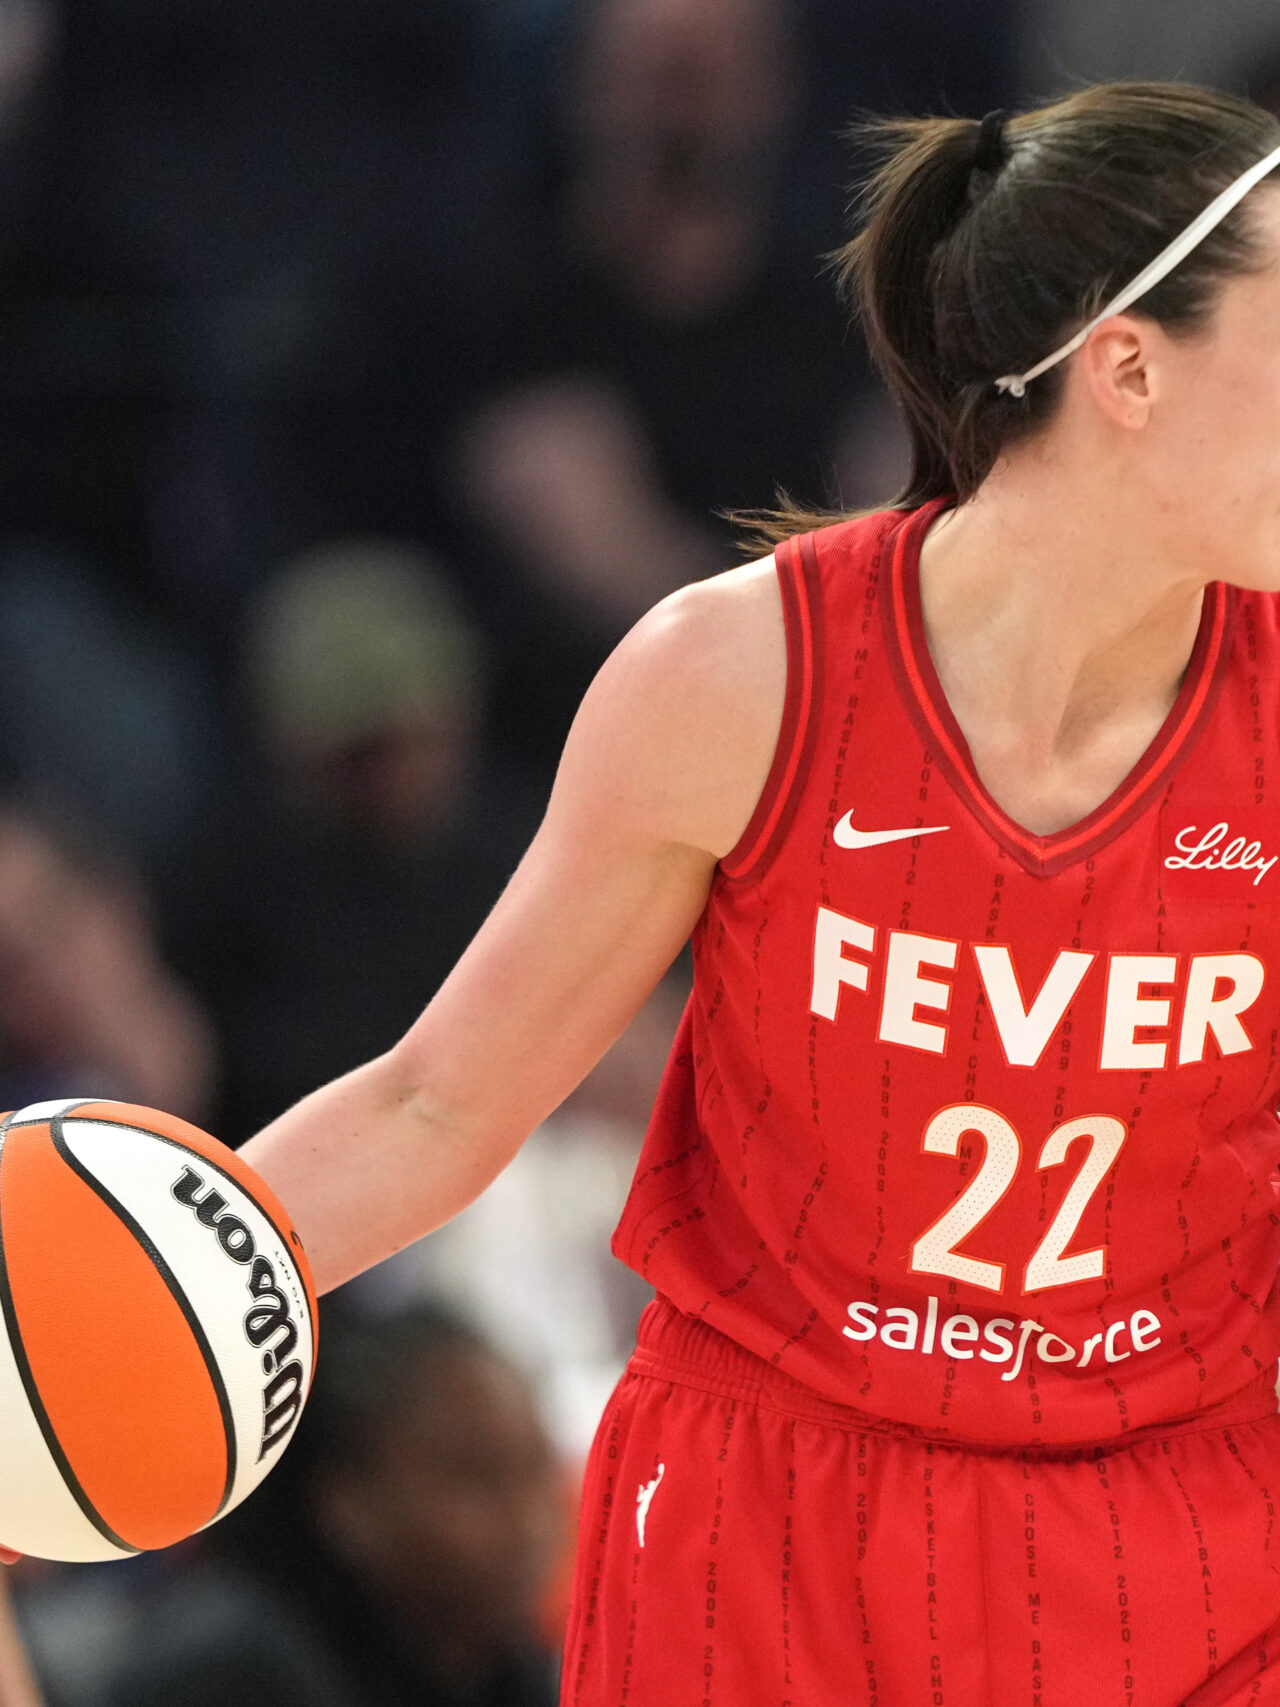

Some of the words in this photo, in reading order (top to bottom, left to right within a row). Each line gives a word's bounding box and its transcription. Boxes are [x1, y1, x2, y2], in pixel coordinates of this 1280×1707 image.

[854, 648, 869, 681] ME
[1249, 674, 1262, 743] 2012
[819, 694, 859, 866] BASKETBALL
[917, 748, 934, 802] 009
[1253, 756, 1266, 806] 202
[1080, 856, 1097, 906] 020
[1164, 822, 1279, 887] Lilly
[809, 904, 1268, 1073] FEVER
[958, 1145, 973, 1177] ME
[793, 1160, 829, 1241] CHOSE
[909, 1103, 1129, 1295] 22
[1038, 1168, 1048, 1223] 012
[170, 1163, 304, 1465] Wilson
[842, 1296, 1163, 1382] salesforce
[606, 1409, 623, 1461] 020
[855, 1493, 870, 1562] 2009
[922, 1467, 940, 1641] BASKETBALL
[1023, 1492, 1039, 1579] CHOSE
[1106, 1500, 1125, 1560] 2012
[705, 1561, 718, 1630] 2009
[781, 1514, 795, 1685] BASKETBALL
[855, 1577, 873, 1645] 2012
[1027, 1592, 1042, 1626] ME
[1116, 1573, 1133, 1643] 2020
[864, 1659, 880, 1707] 202
[929, 1654, 945, 1707] CHO
[1123, 1657, 1136, 1707] 197
[1205, 1628, 1218, 1676] CHO
